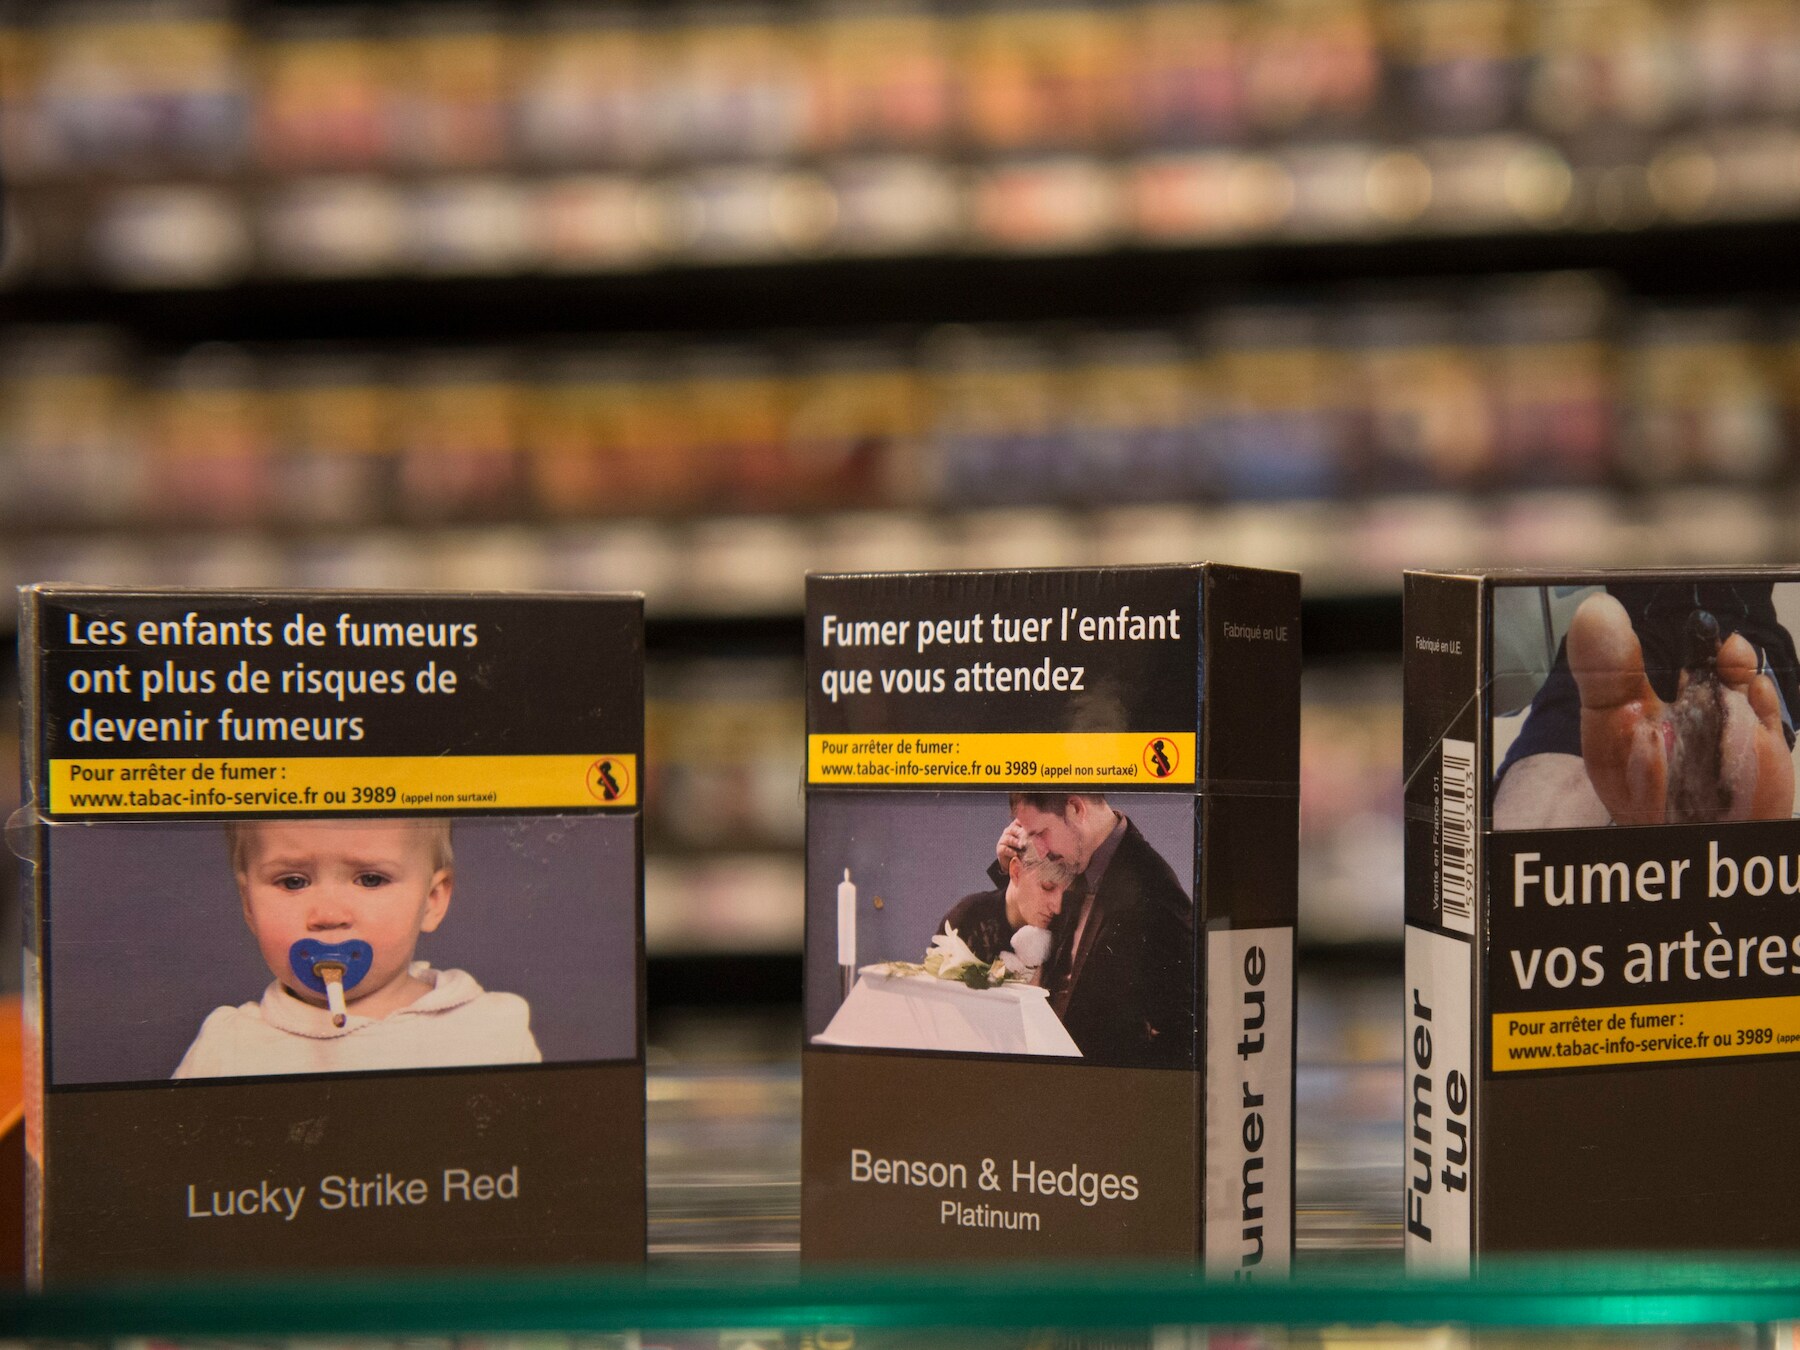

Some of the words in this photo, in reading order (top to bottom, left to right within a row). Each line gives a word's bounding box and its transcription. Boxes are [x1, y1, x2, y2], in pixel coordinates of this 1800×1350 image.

[67, 613, 127, 646] Les
[137, 613, 273, 646] enfants
[283, 613, 327, 647] de
[336, 613, 479, 647] fumeurs
[822, 615, 910, 647] Fumer
[917, 613, 984, 653] peut
[991, 613, 1052, 643] tuer
[1060, 605, 1181, 642] l’enfant
[1223, 622, 1261, 642] Fabriqué
[1263, 628, 1273, 640] en
[1275, 626, 1288, 641] UE
[1415, 635, 1440, 653] Fabriqué
[1440, 641, 1449, 653] en
[1449, 640, 1463, 655] U.E.
[68, 663, 131, 694] ont
[141, 660, 216, 702] plus
[227, 661, 270, 694] de
[281, 661, 406, 702] risques
[415, 661, 458, 694] de
[821, 667, 872, 702] que
[880, 665, 945, 694] vous
[954, 657, 1085, 693] attendez
[68, 709, 209, 742] devenir
[218, 709, 365, 742] fumeurs
[821, 740, 848, 755] Pour
[851, 739, 894, 755] arrêter
[896, 740, 912, 754] de
[915, 740, 953, 754] fumer
[69, 765, 115, 783] Pour
[119, 762, 187, 782] arrêter
[192, 764, 215, 781] de
[220, 762, 277, 781] fumer
[821, 761, 981, 777] www.tabac-info-service.fr
[984, 763, 1001, 776] ou
[1004, 761, 1038, 776] 3989
[1040, 764, 1073, 777] (appel
[1075, 766, 1094, 776] non
[1095, 763, 1138, 777] surtaxé)
[69, 787, 319, 808] www.tabac-info-service.fr
[323, 790, 347, 806] ou
[351, 787, 397, 805] 3989
[401, 792, 432, 805] (appel
[434, 794, 453, 803] non
[456, 791, 497, 804] surtaxé)
[1465, 771, 1474, 830] 9303
[1433, 849, 1440, 867] en
[1465, 848, 1474, 907] 5903
[1513, 851, 1690, 908] Fumer
[1708, 840, 1800, 898] bou
[1510, 944, 1605, 990] vos
[1237, 944, 1266, 1061] tue
[1509, 1020, 1545, 1036] Pour
[1550, 1016, 1604, 1034] arrêter
[1607, 1014, 1626, 1031] de
[1630, 1013, 1677, 1029] fumer
[1509, 1031, 1710, 1060] www.tabac-info-service.fr
[1713, 1033, 1732, 1047] ou
[1736, 1028, 1773, 1045] 3989
[1407, 988, 1433, 1243] Fumer
[1441, 1069, 1468, 1193] tue
[186, 1180, 306, 1221] Lucky
[319, 1172, 429, 1210] Strike
[443, 1166, 520, 1202] Red
[850, 1148, 967, 1189] Benson
[978, 1158, 1002, 1191] &
[1011, 1160, 1139, 1206] Hedges
[1235, 1081, 1265, 1284] umer
[940, 1201, 1040, 1232] Platinum
